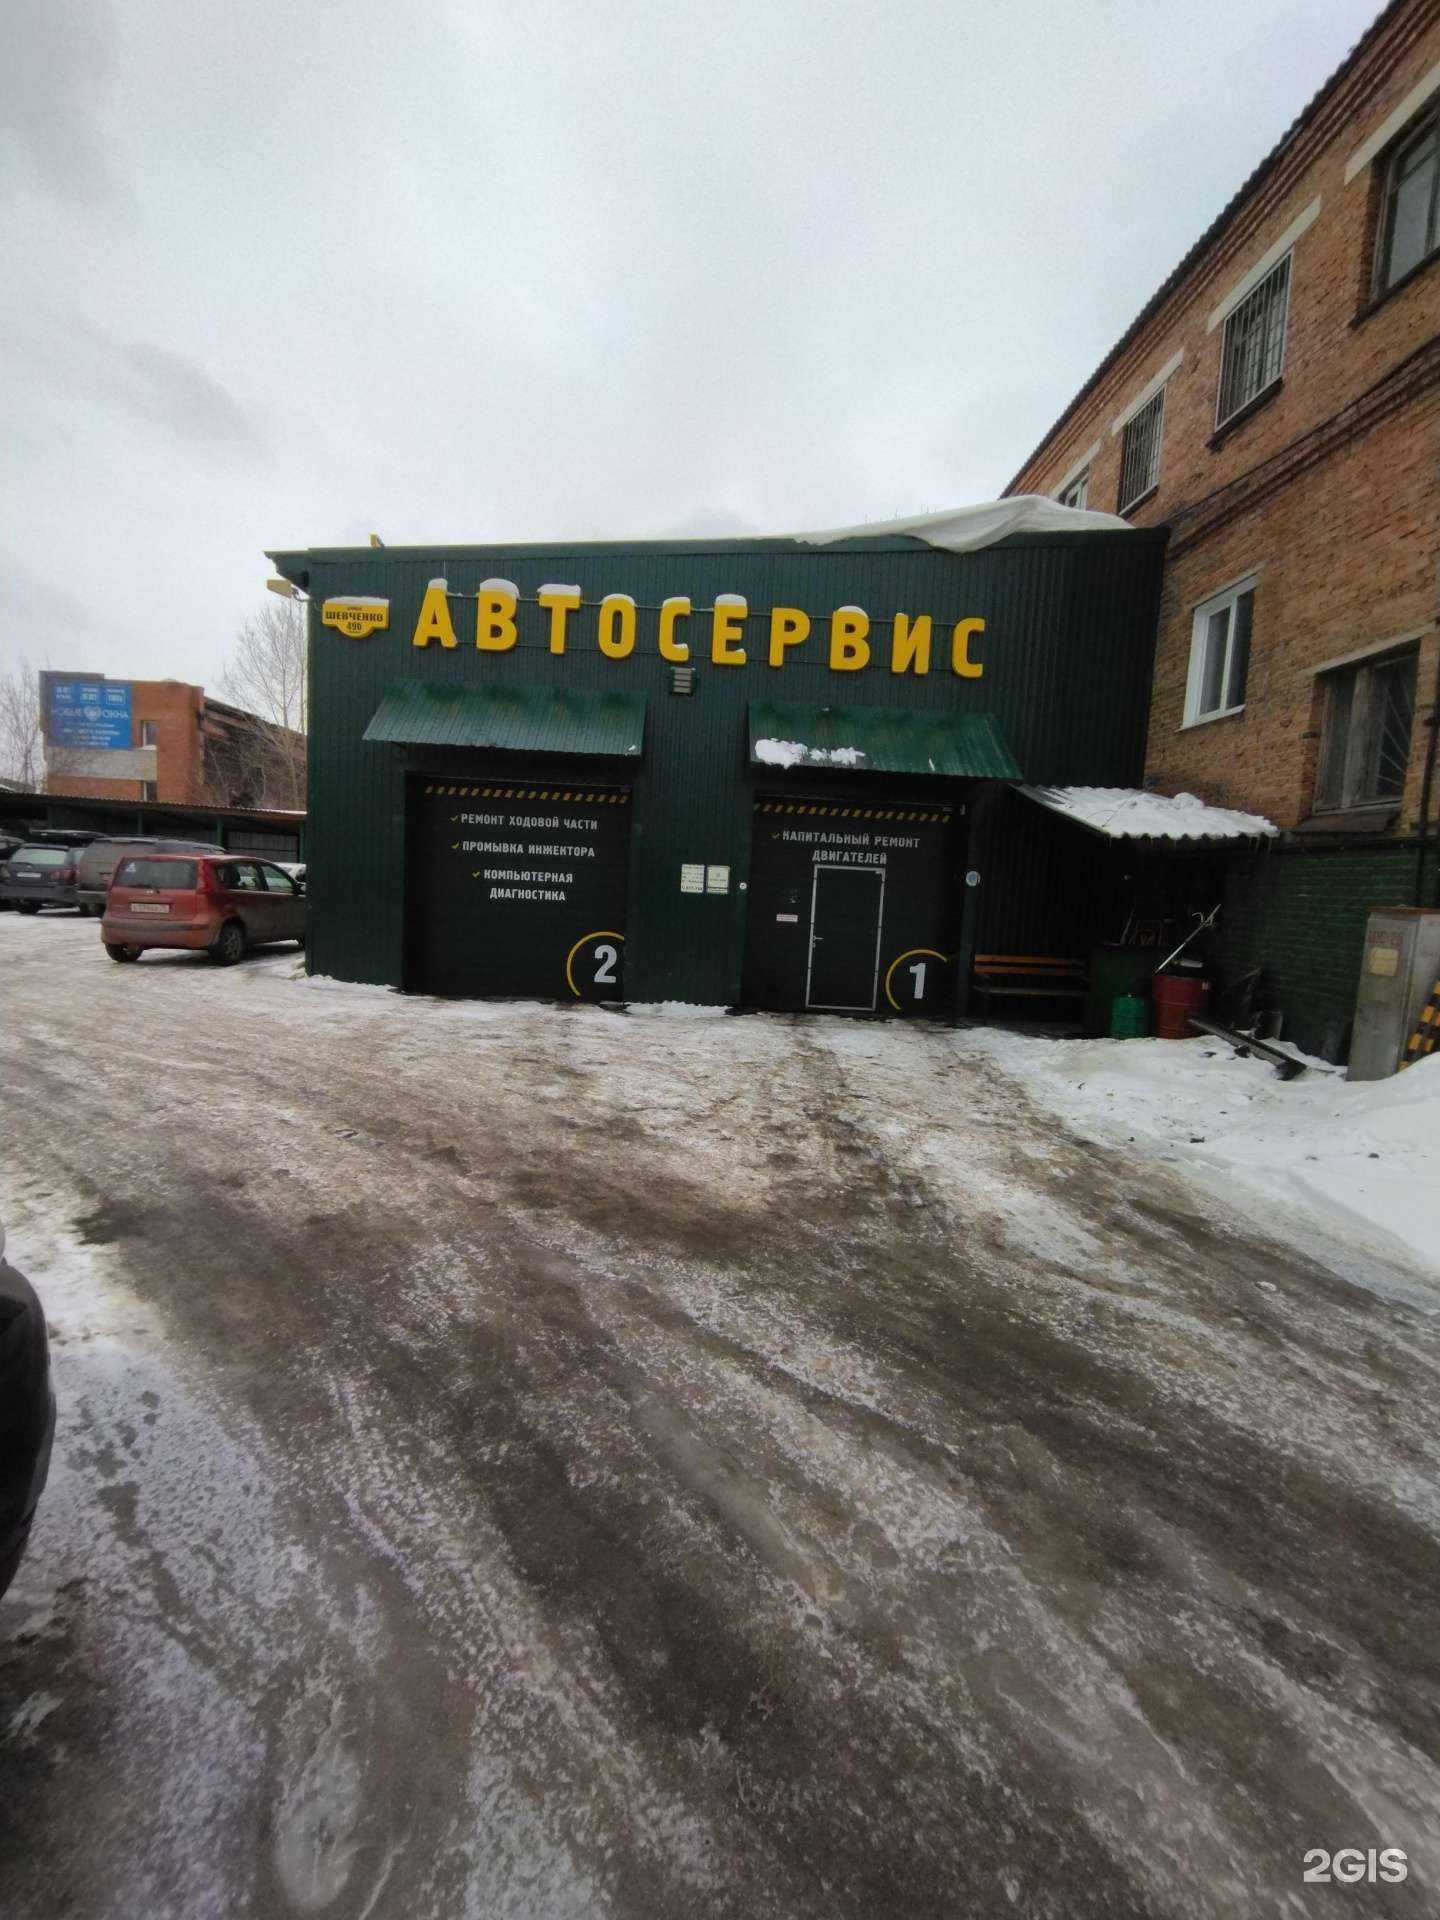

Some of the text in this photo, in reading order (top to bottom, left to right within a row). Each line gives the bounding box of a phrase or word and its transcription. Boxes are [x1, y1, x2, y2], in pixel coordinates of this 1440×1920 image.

[325, 610, 383, 622] ШЕВЧЕНКО
[412, 578, 985, 678] АВТОСЕРВИС
[460, 813, 598, 830] РЕМОНТ ХОДОВОЙ ЧАСТИ
[782, 830, 920, 848] КАПИТАЛЬНЫЙ РЕМОНТ
[462, 841, 595, 857] ПРОМЫВКА ИНЖЕКТОРА
[811, 849, 887, 864] ДВИГАТЕЛЕЙ
[484, 869, 573, 883] КОМПЬЮТЕРНАЯ
[489, 888, 566, 901] ДИАГНОСТИКА
[594, 944, 618, 984] 2
[909, 962, 926, 999] 1
